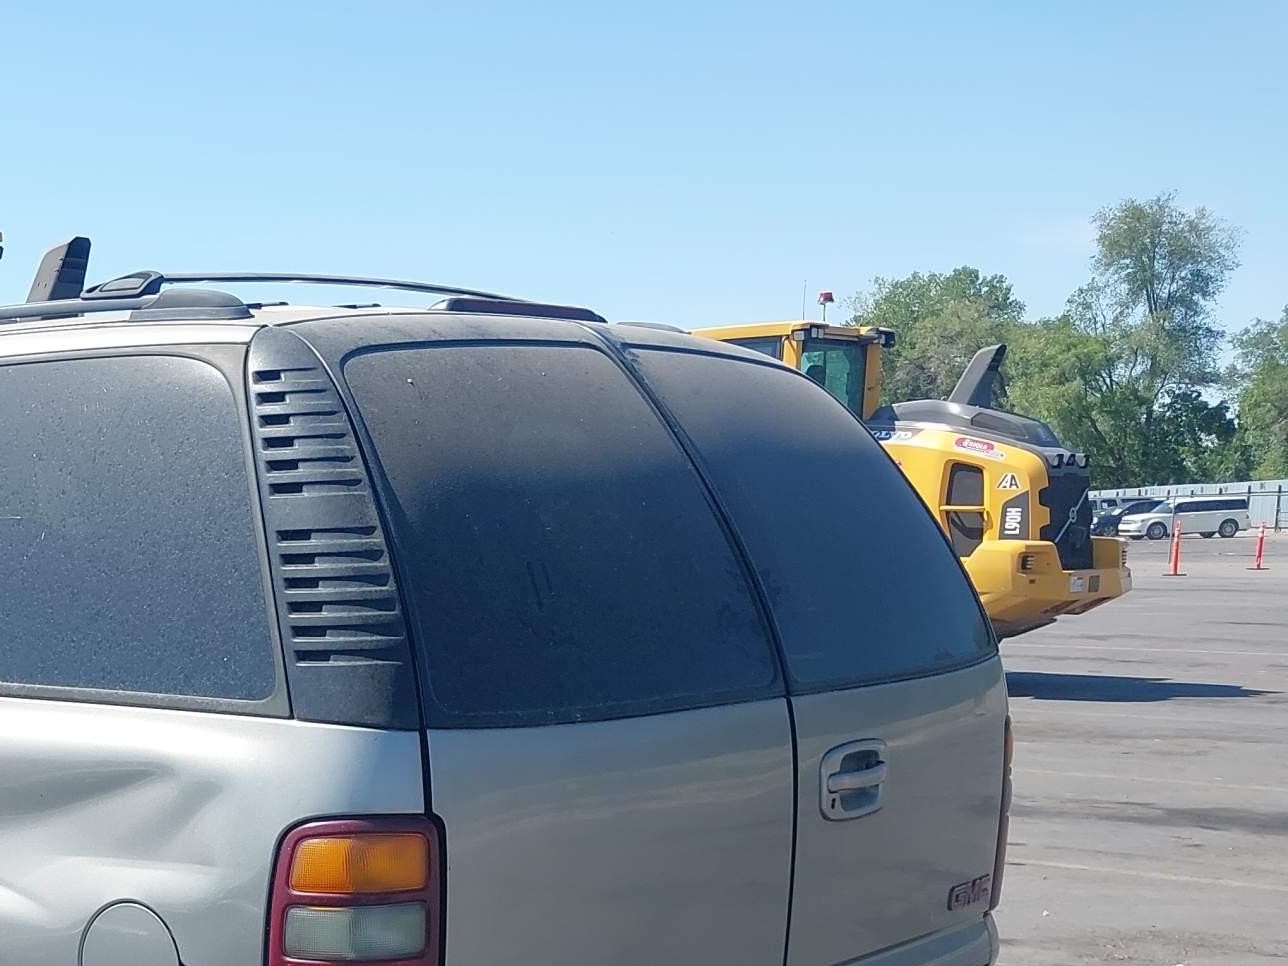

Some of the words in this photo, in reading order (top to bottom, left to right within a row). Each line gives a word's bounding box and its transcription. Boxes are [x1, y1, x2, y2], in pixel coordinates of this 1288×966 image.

[872, 430, 913, 441] OLVO
[1004, 507, 1022, 535] L90H
[948, 874, 990, 910] GMC
